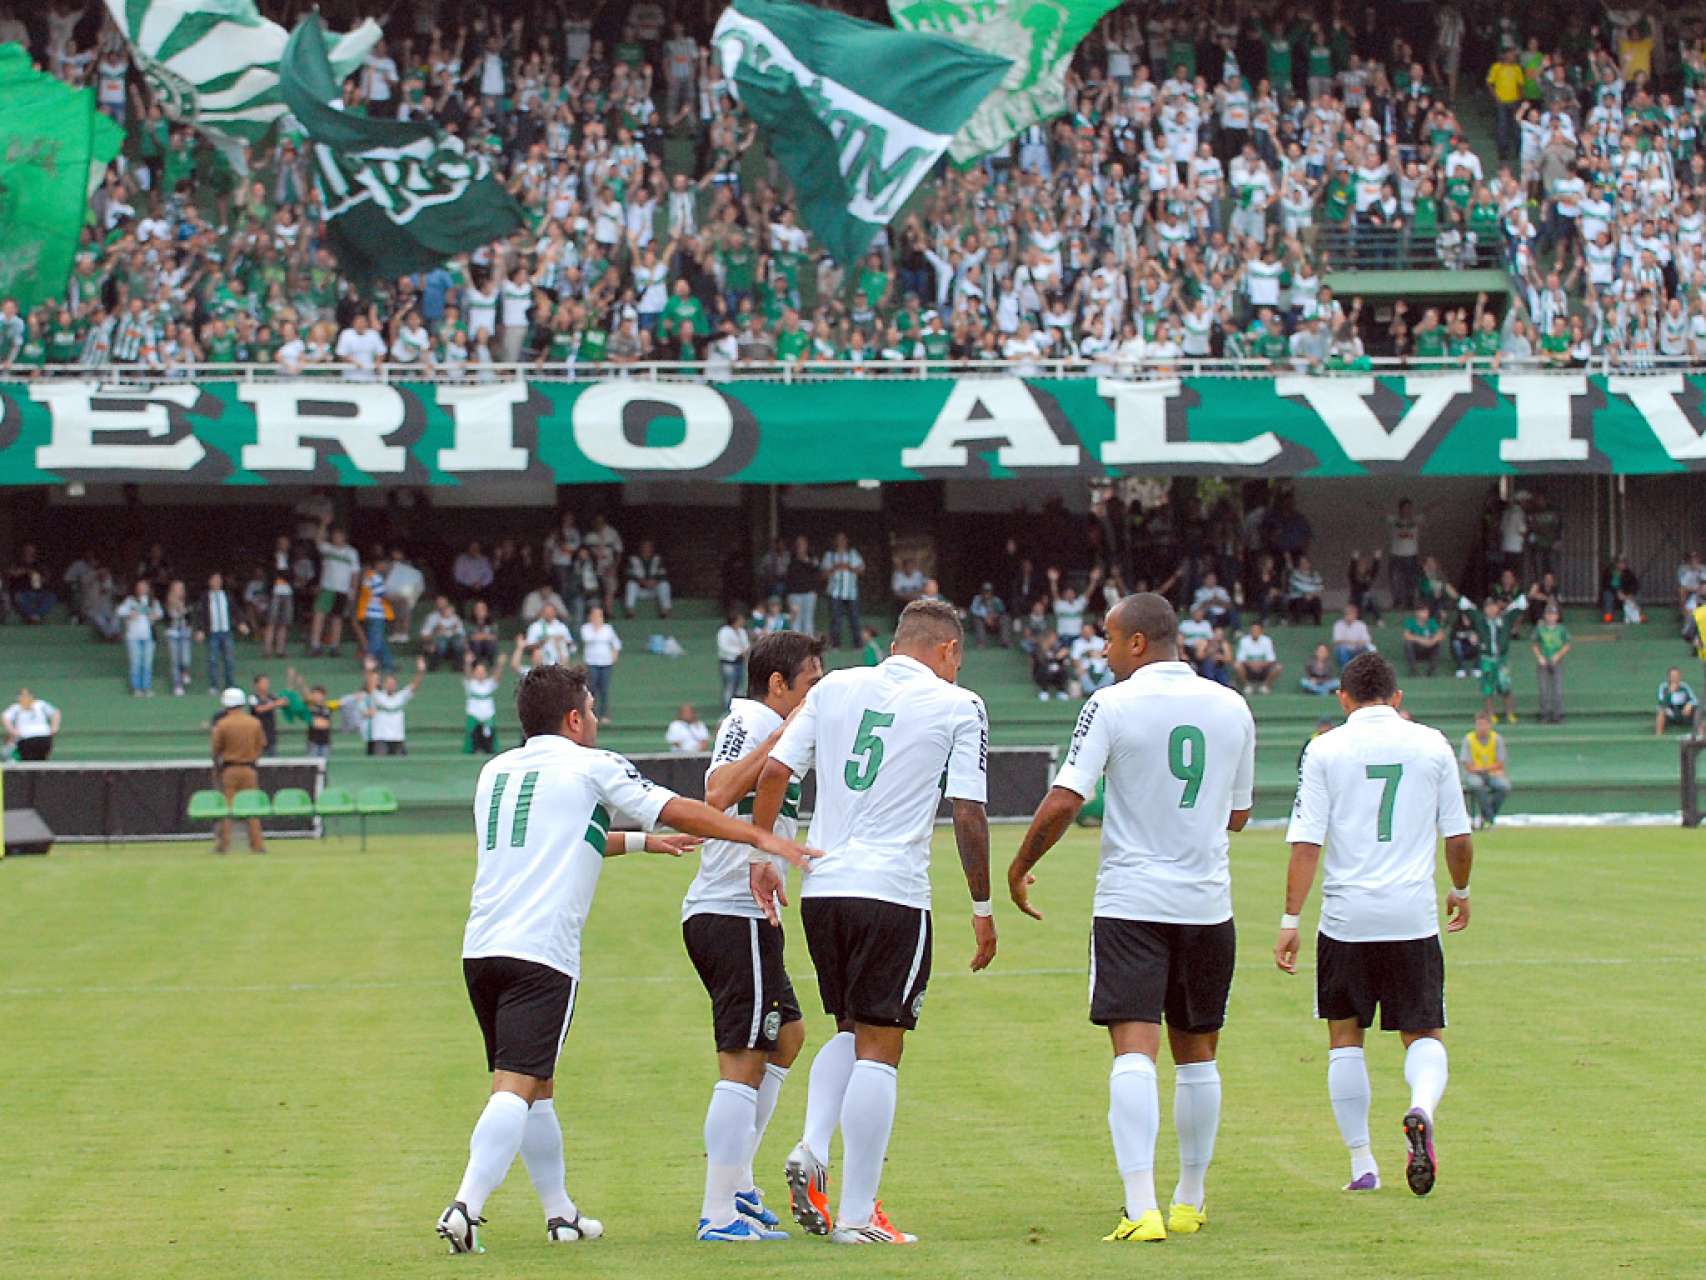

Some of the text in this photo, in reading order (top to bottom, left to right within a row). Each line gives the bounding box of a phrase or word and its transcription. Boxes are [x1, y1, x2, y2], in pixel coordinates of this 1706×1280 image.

[0, 380, 733, 471] ERIO
[844, 709, 894, 791] 5
[1168, 724, 1206, 809] 9
[486, 771, 540, 851] 11
[1366, 763, 1404, 842] 7
